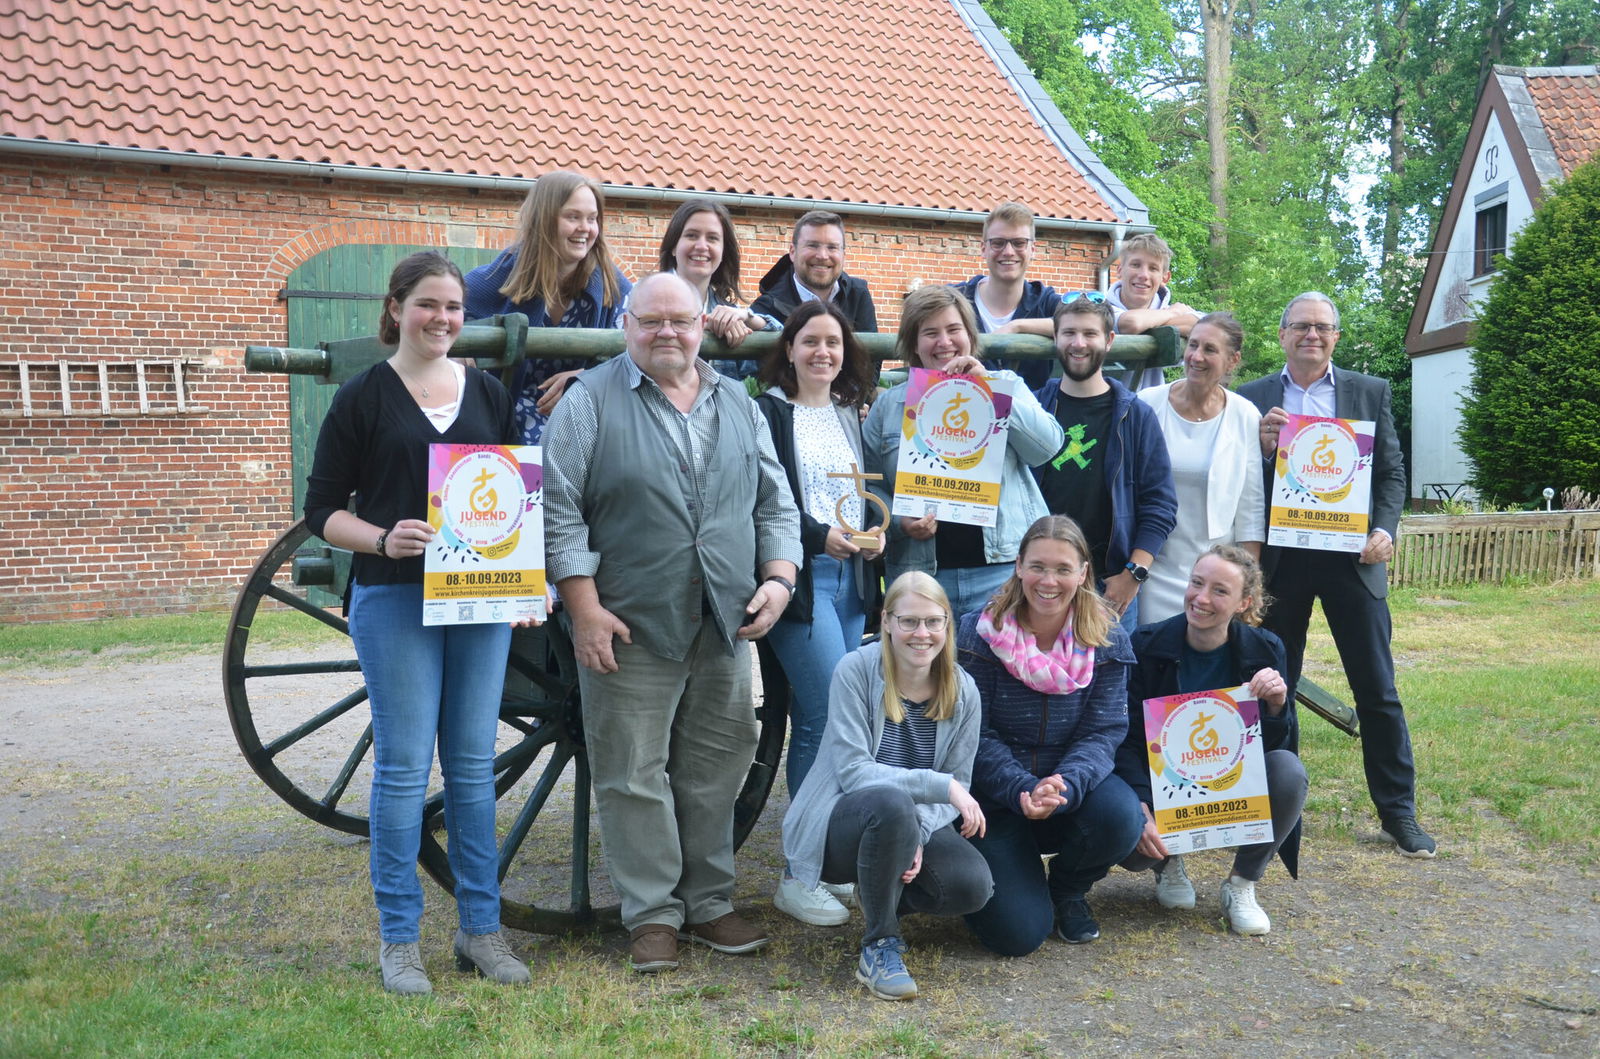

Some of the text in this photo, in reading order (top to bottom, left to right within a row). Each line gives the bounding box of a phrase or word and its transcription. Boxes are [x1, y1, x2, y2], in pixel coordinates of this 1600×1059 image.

[930, 426, 976, 438] JUGEND
[936, 435, 968, 443] FESTIVAL
[1302, 464, 1342, 475] JUGEND
[915, 475, 981, 492] 08.-10.09.2023
[460, 511, 506, 523] JUGEND
[1288, 509, 1350, 522] 08.-10.09.2023
[464, 520, 498, 528] FESTIVAL
[446, 572, 522, 586] 08.-10.09.2023
[435, 588, 533, 597] www.kirchenkreisjugenddienst.com
[1181, 746, 1229, 764] JUGEND
[1187, 758, 1222, 766] FESTIVAL
[1175, 800, 1248, 819] 08.-10.09.2023
[1167, 814, 1260, 831] www.kirchenkreisjugenddienst.com
